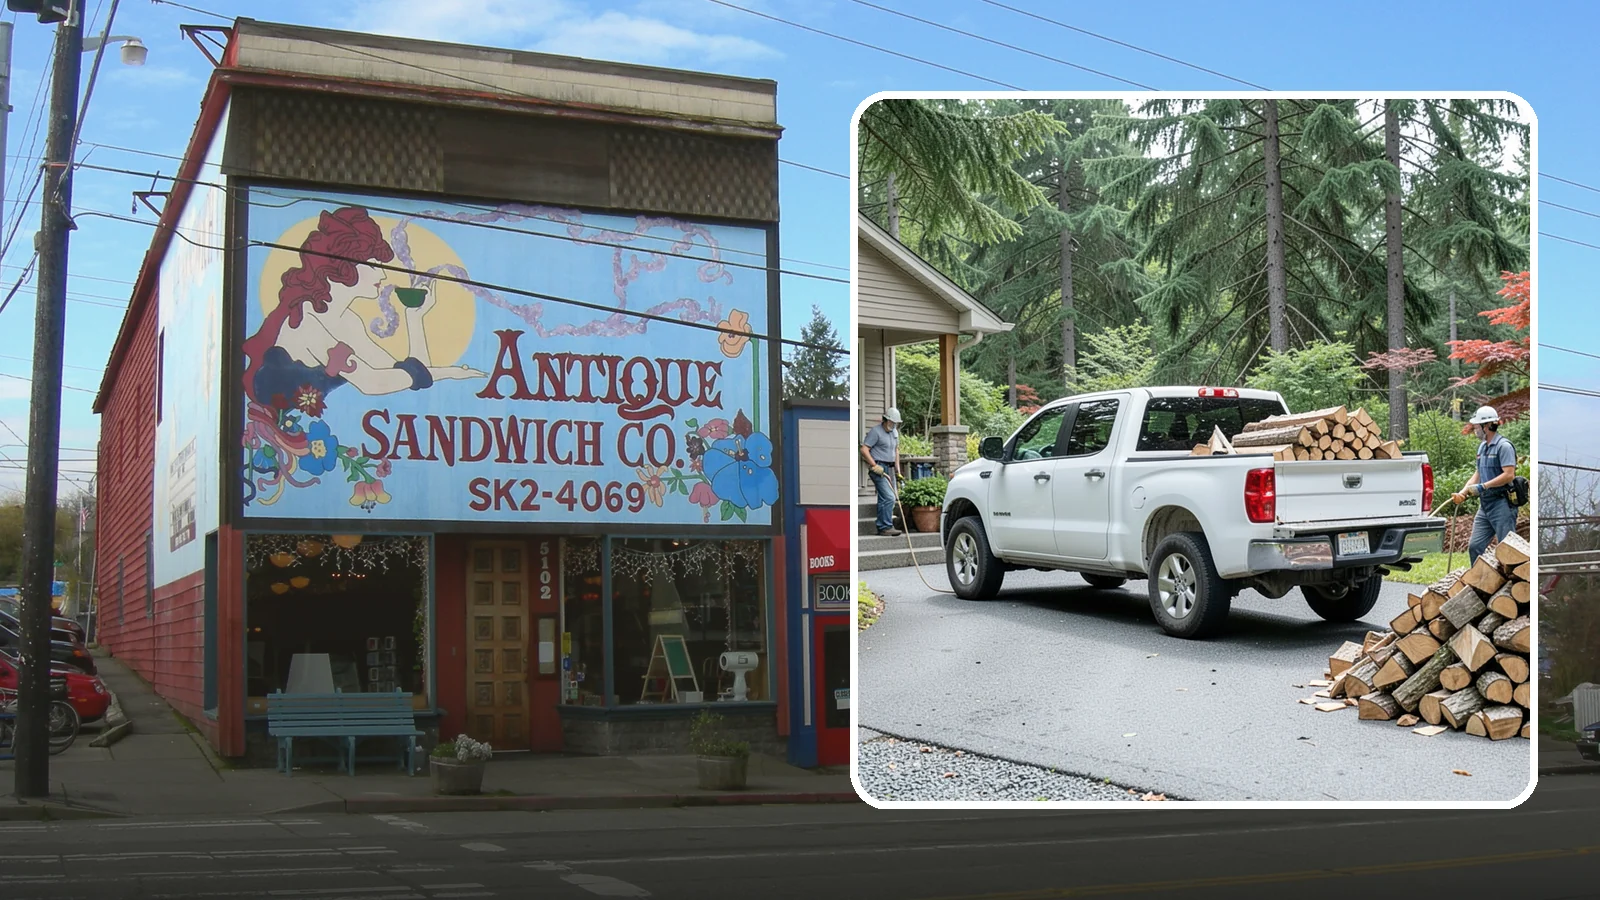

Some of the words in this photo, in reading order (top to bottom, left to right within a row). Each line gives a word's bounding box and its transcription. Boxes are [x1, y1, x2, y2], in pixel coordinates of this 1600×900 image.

[475, 329, 723, 420] ANTIQUE
[361, 408, 604, 467] SANDWICH
[617, 421, 685, 468] CO.
[468, 477, 646, 513] SK2-4069
[540, 541, 551, 600] 5102
[809, 555, 834, 569] BOOKS
